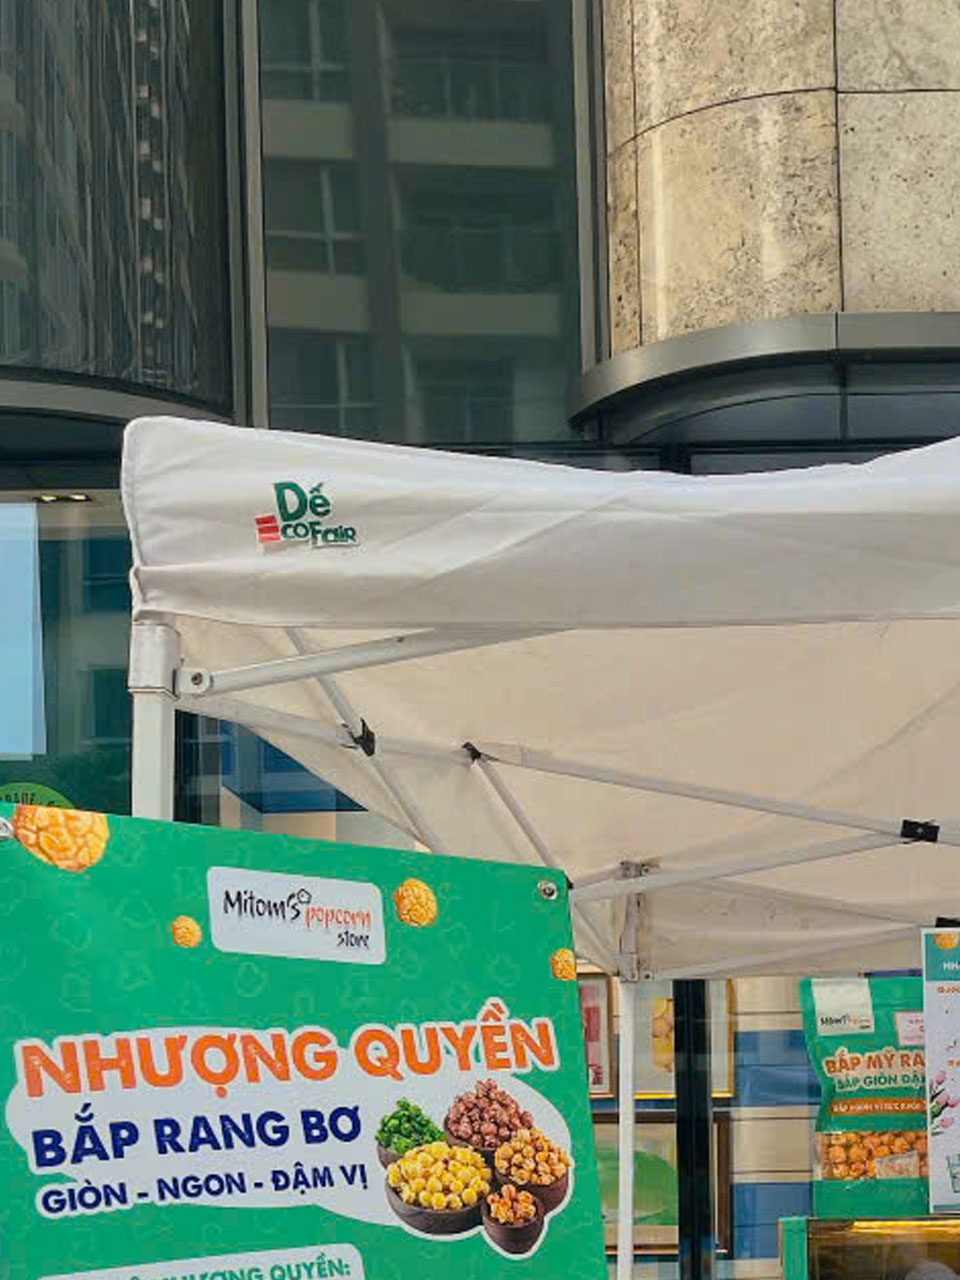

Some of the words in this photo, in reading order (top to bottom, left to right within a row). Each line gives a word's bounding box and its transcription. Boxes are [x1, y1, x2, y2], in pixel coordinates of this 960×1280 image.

[304, 904, 372, 931] popcorn
[337, 928, 370, 949] store
[22, 1030, 338, 1098] NHƯỢNG
[353, 1003, 555, 1080] QUYỀN
[900, 1053, 925, 1068] RA
[32, 1103, 139, 1168] BẮP
[154, 1114, 290, 1156] RANG
[302, 1106, 362, 1145] BƠ
[41, 1182, 128, 1215] GIÒN
[157, 1173, 248, 1202] NGON
[272, 1163, 333, 1195] ĐẬM
[341, 1164, 368, 1192] VỊ
